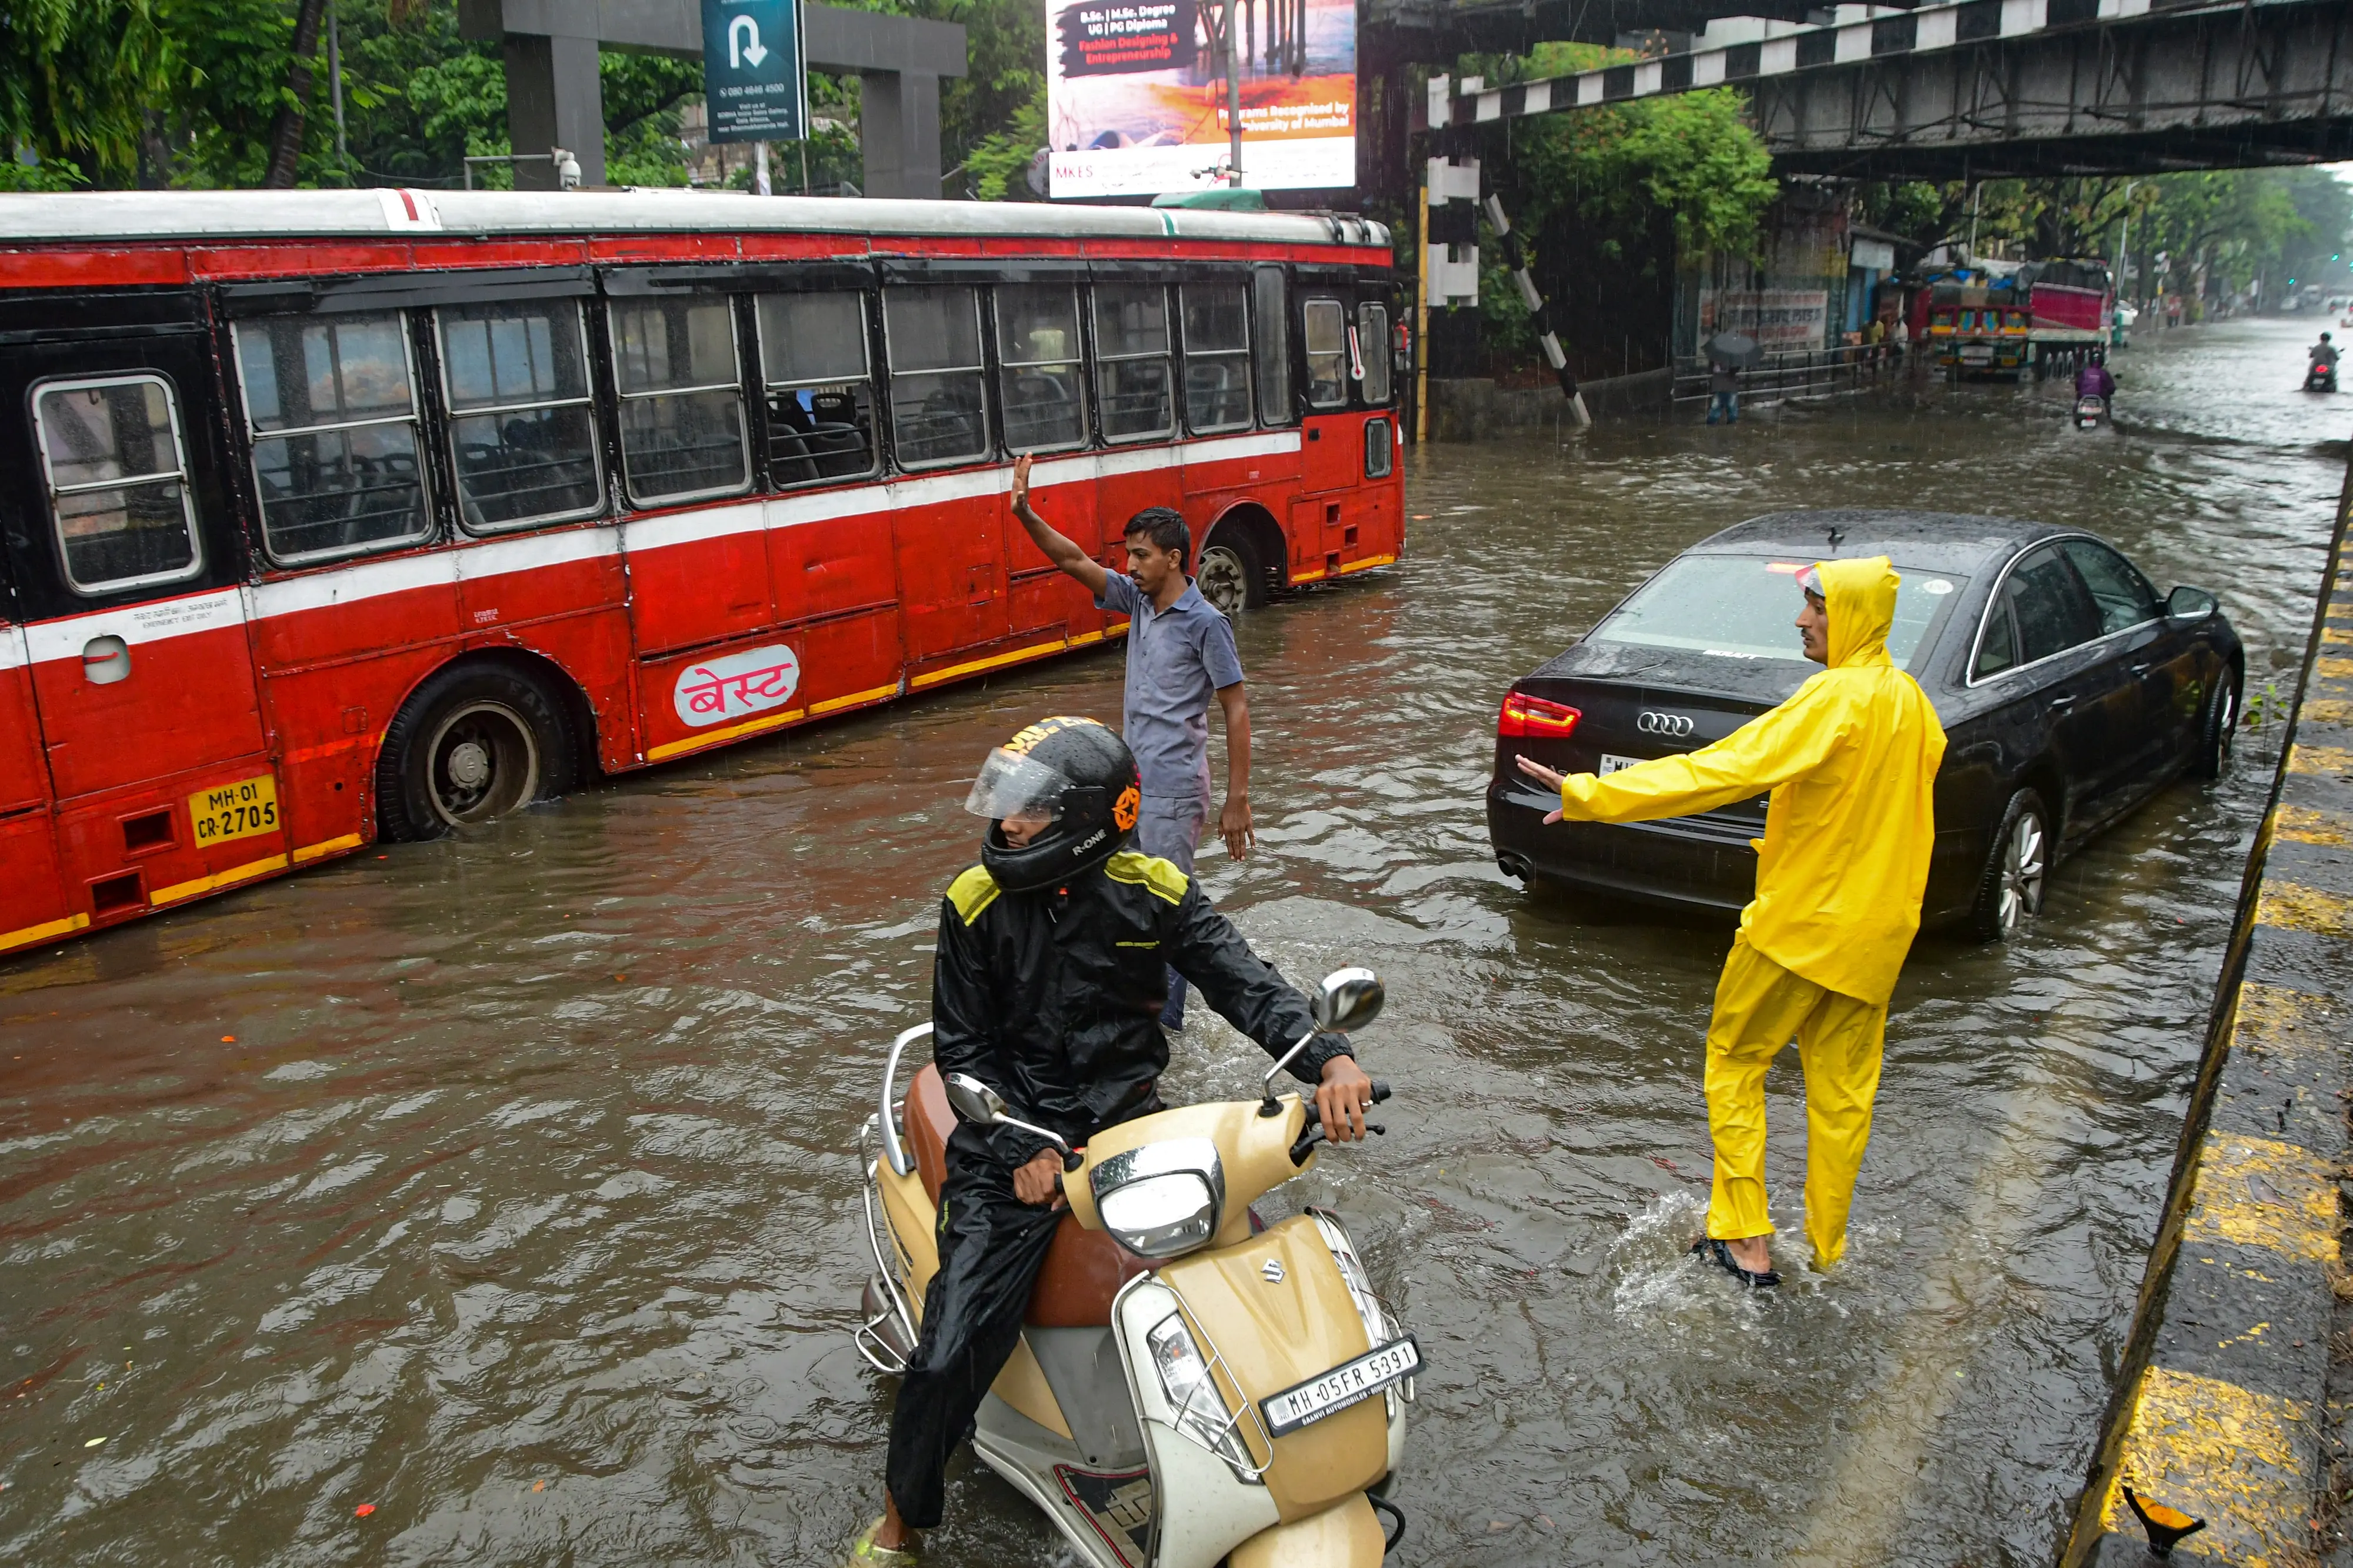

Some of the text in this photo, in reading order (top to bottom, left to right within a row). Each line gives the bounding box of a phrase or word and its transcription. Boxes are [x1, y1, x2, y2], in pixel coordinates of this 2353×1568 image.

[1139, 4, 1176, 18] Degree
[1088, 24, 1103, 36] UG
[1110, 21, 1124, 33] PG
[1125, 18, 1168, 32] Diploma
[1079, 38, 1116, 52] Fashion
[1118, 34, 1168, 48] Designing
[1086, 46, 1171, 65] Entrepreneurship
[1218, 102, 1349, 119] Prrams Recognised by
[1241, 115, 1349, 132] niversity of Mumbai
[1056, 165, 1093, 178] MKES
[681, 662, 793, 713] बेस्ट
[209, 783, 257, 810] MH-01
[198, 802, 275, 838] CR-2705
[1072, 829, 1107, 856] R-ONE
[1369, 1347, 1411, 1378] 5391
[1324, 1392, 1368, 1415] AUTOMOBILES
